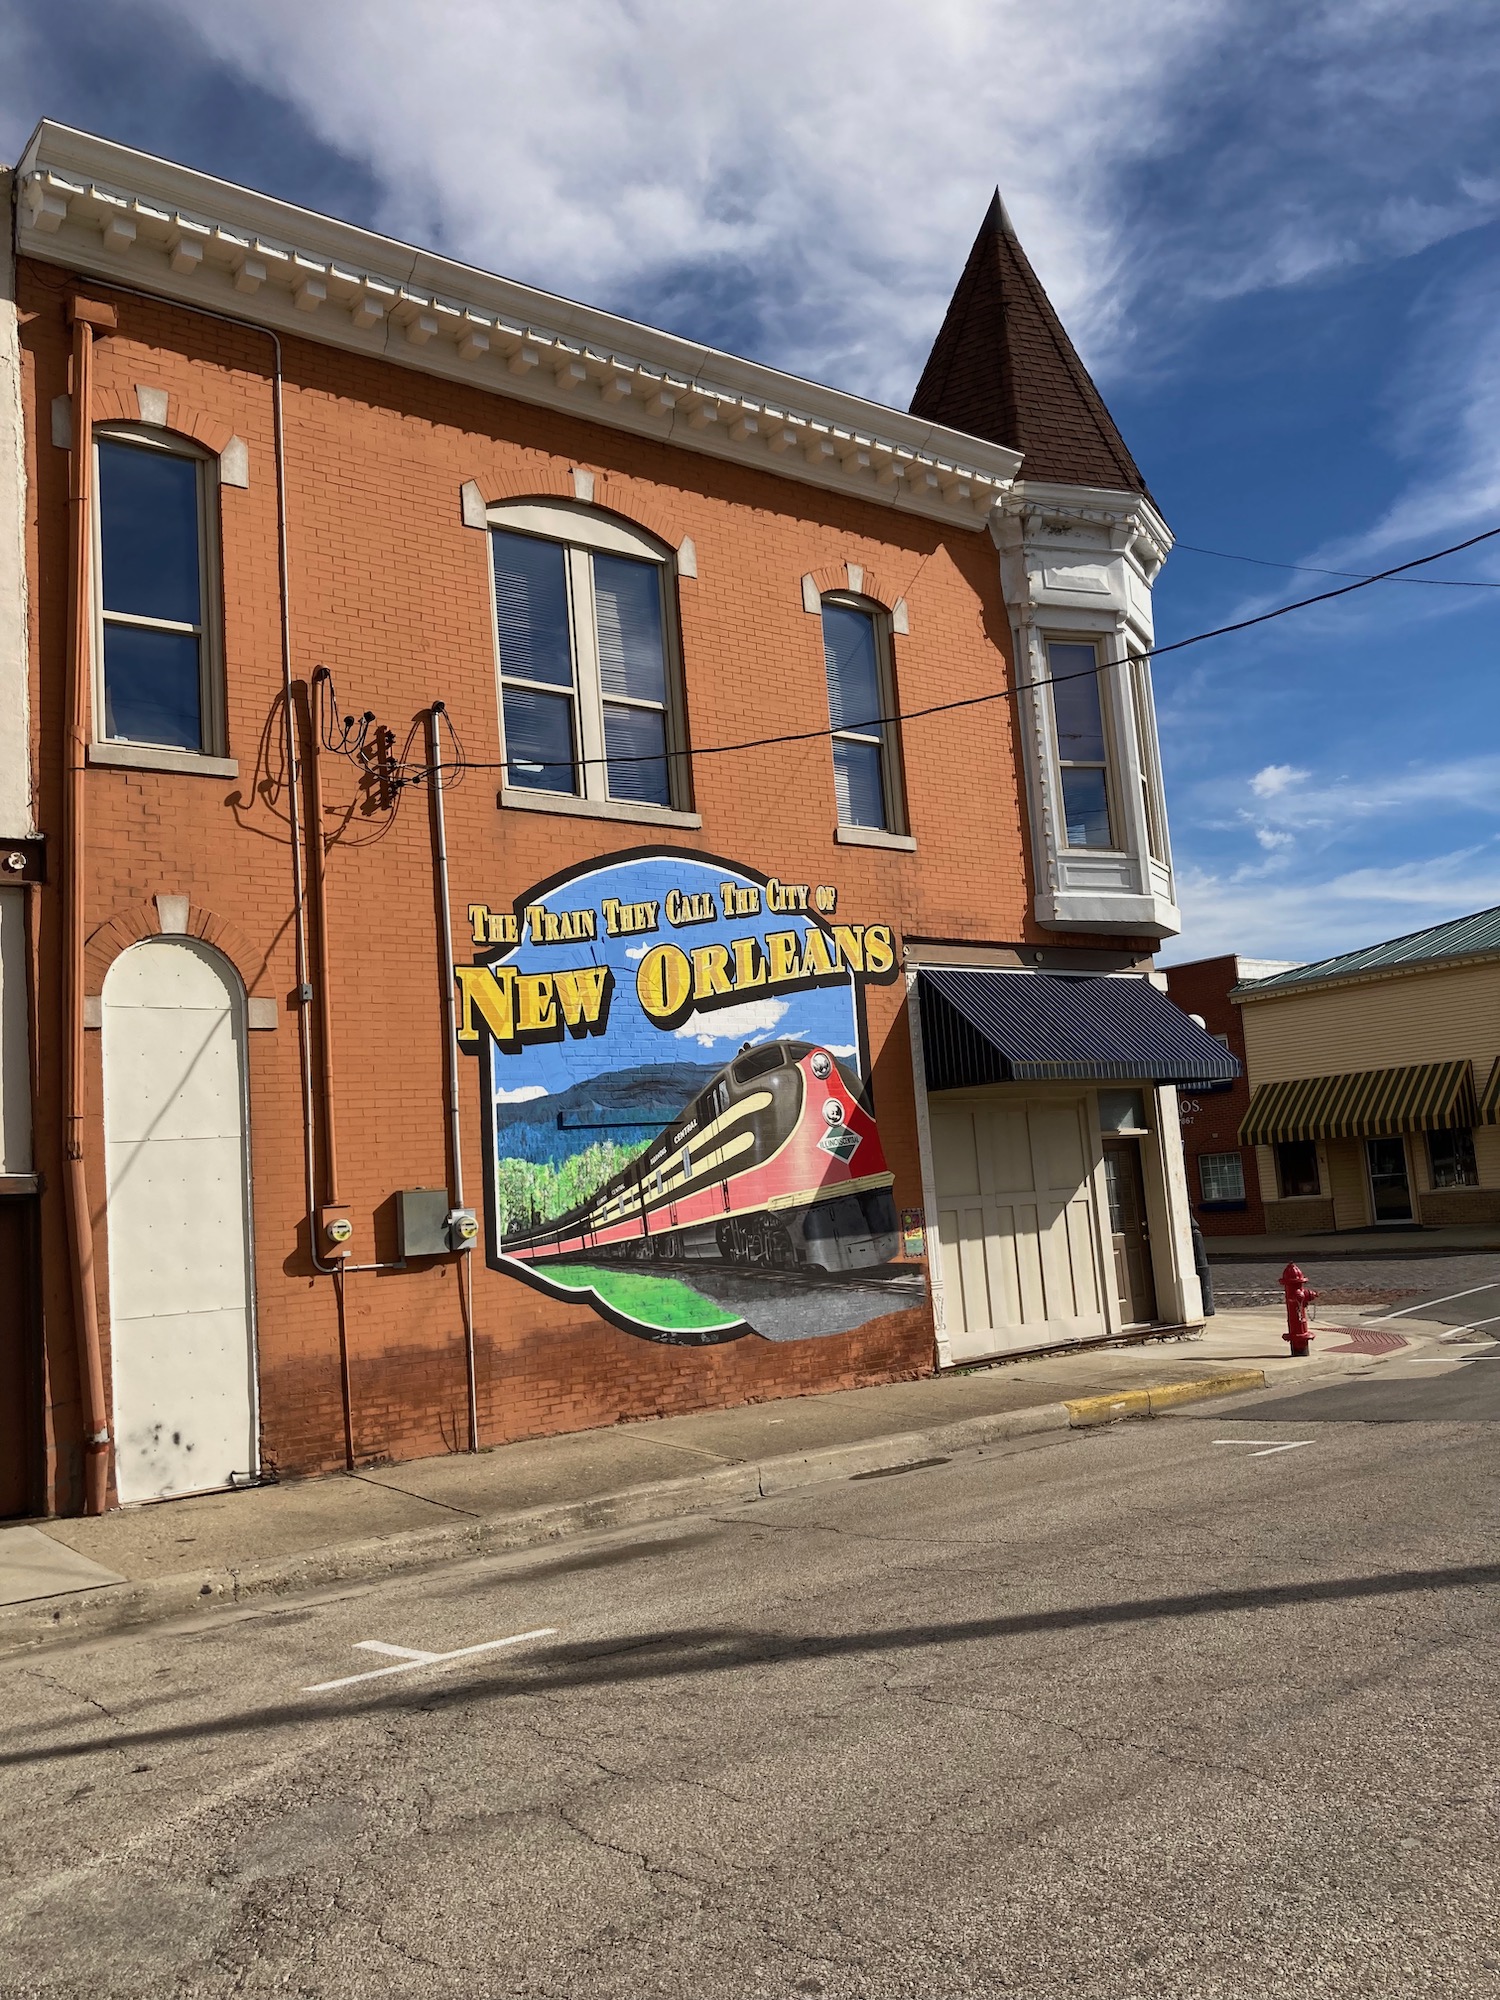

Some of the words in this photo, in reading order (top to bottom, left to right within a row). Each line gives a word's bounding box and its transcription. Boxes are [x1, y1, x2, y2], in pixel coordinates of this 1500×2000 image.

[468, 904, 519, 944] THE
[525, 905, 596, 942] TRAIN
[602, 898, 658, 934] THEY
[665, 889, 714, 925] CALL
[720, 882, 760, 917] THE
[766, 878, 809, 911] CITY
[815, 885, 837, 913] OF
[455, 965, 609, 1042] NEW
[636, 924, 895, 1018] ORLEANS
[673, 1118, 698, 1144] CENTRAL
